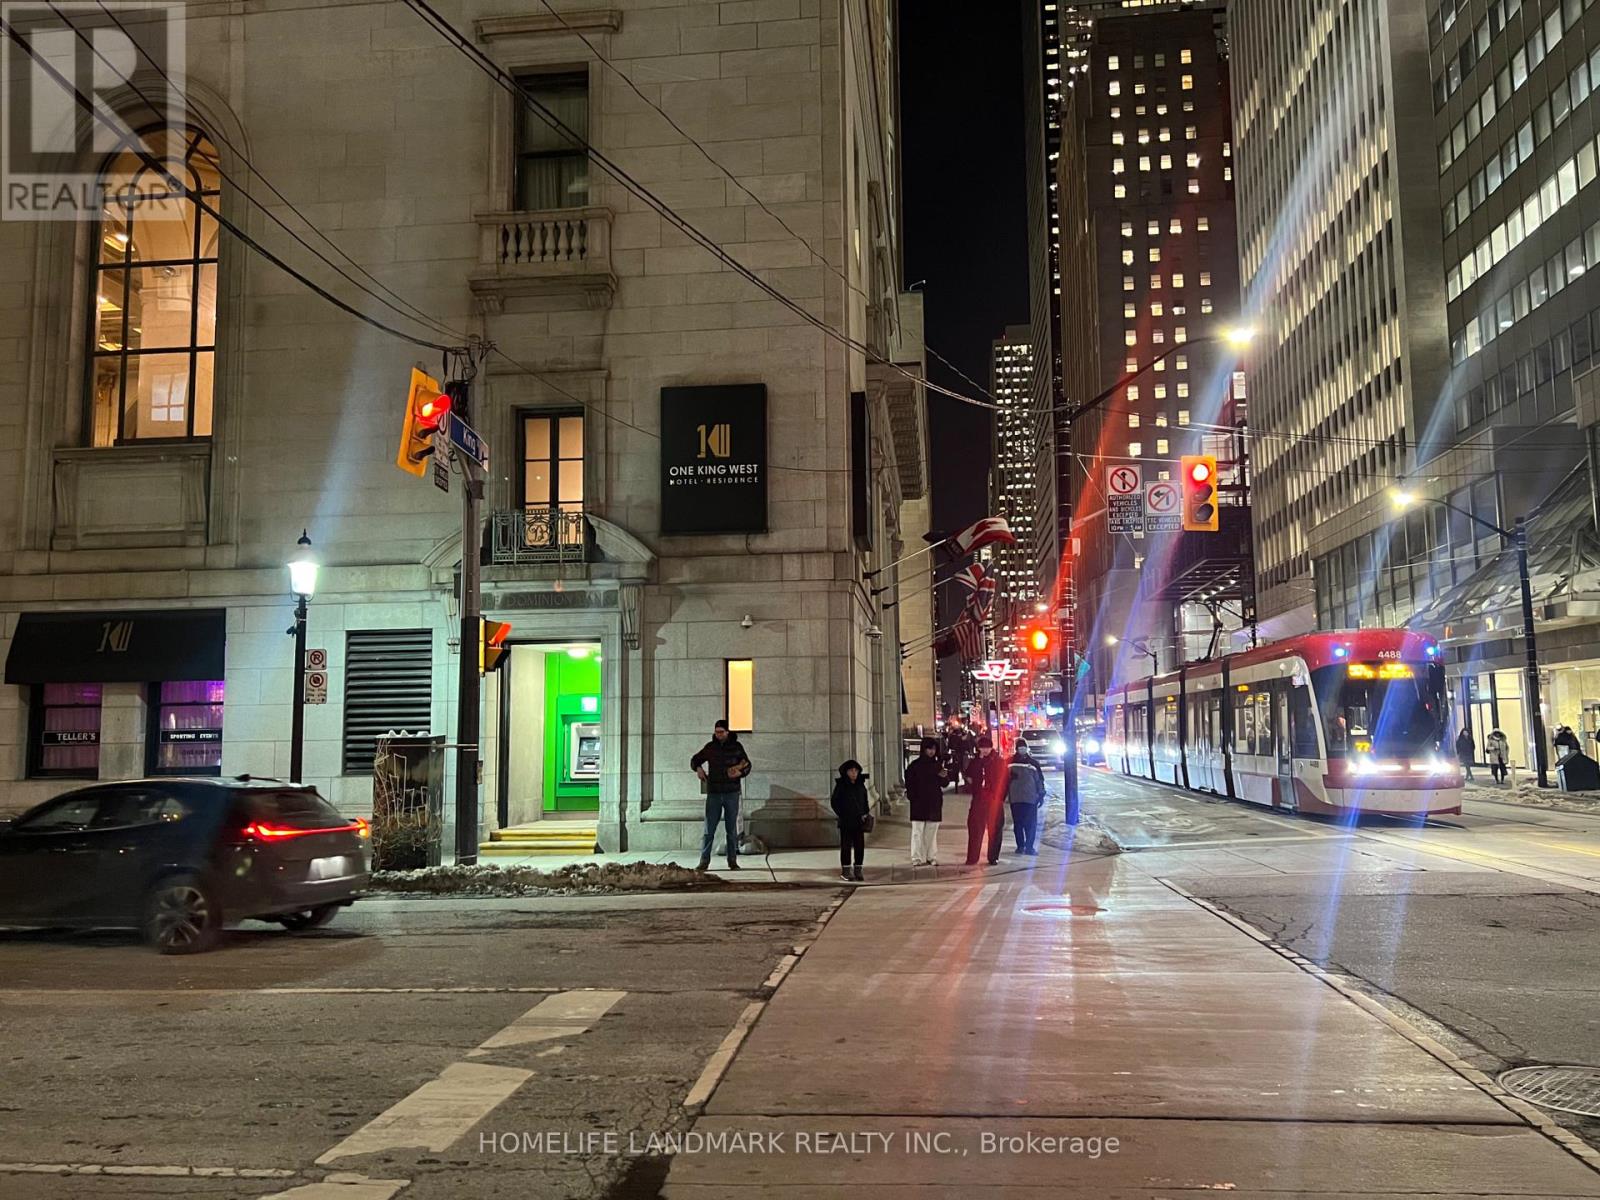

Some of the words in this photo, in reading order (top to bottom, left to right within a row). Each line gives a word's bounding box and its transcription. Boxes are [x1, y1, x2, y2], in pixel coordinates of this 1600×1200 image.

[462, 426, 476, 455] King
[669, 466, 694, 476] ONE
[697, 465, 727, 475] KING
[729, 464, 759, 474] WEST
[1377, 650, 1402, 659] 4488
[57, 732, 96, 741] TELLER'S
